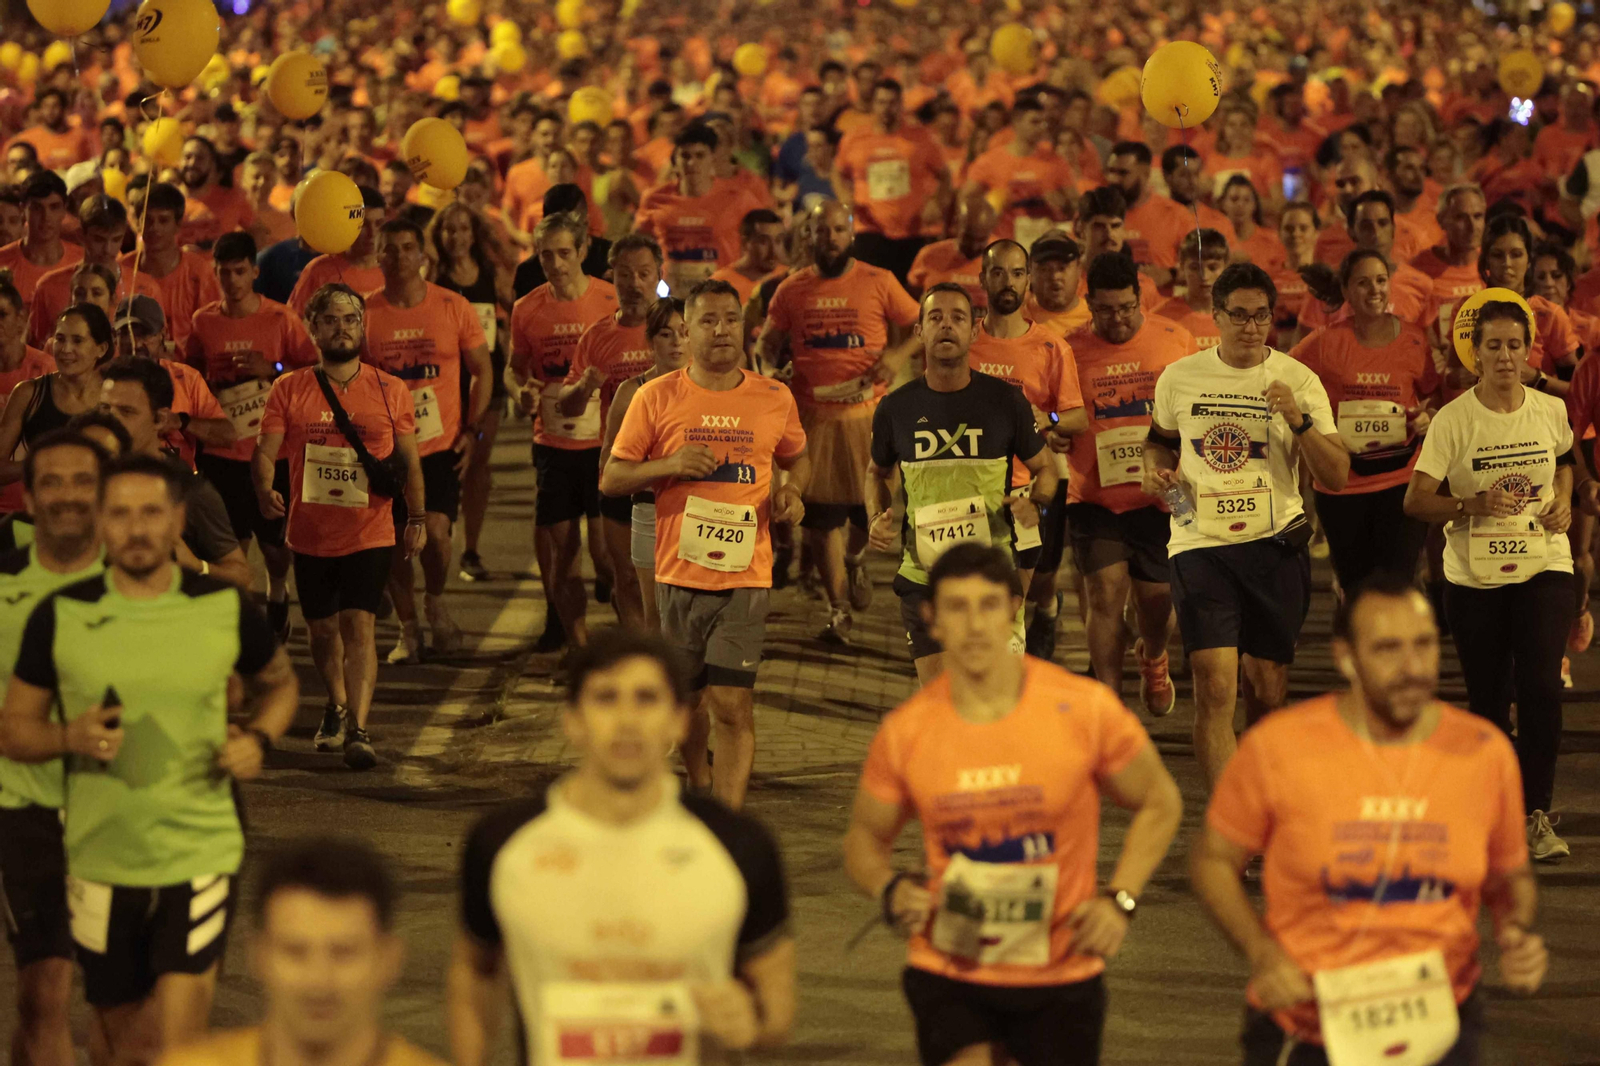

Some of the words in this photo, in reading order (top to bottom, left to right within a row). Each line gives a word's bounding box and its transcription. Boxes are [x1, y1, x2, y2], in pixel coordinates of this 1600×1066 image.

[393, 328, 424, 340] XXXV
[553, 323, 585, 335] XXXV
[979, 362, 1014, 376] XXXV
[1106, 361, 1141, 375] XXXV
[1356, 372, 1391, 384] XXXV
[1199, 393, 1266, 402] ACADEMIA
[229, 397, 265, 418] 22445
[320, 411, 355, 422] XXV
[701, 415, 740, 428] XXXV
[1354, 420, 1389, 433] 8768
[688, 434, 754, 443] GUADALQUIVIR
[1208, 426, 1247, 441] FORENCUR
[914, 423, 983, 459] DXT
[1476, 441, 1540, 452] ACADEMIA
[1209, 457, 1243, 469] IDIOMAS
[316, 466, 357, 482] 15364
[1216, 498, 1256, 514] 5325
[696, 524, 744, 543] 17420
[929, 523, 976, 543] 17412
[1488, 540, 1528, 554] 5322
